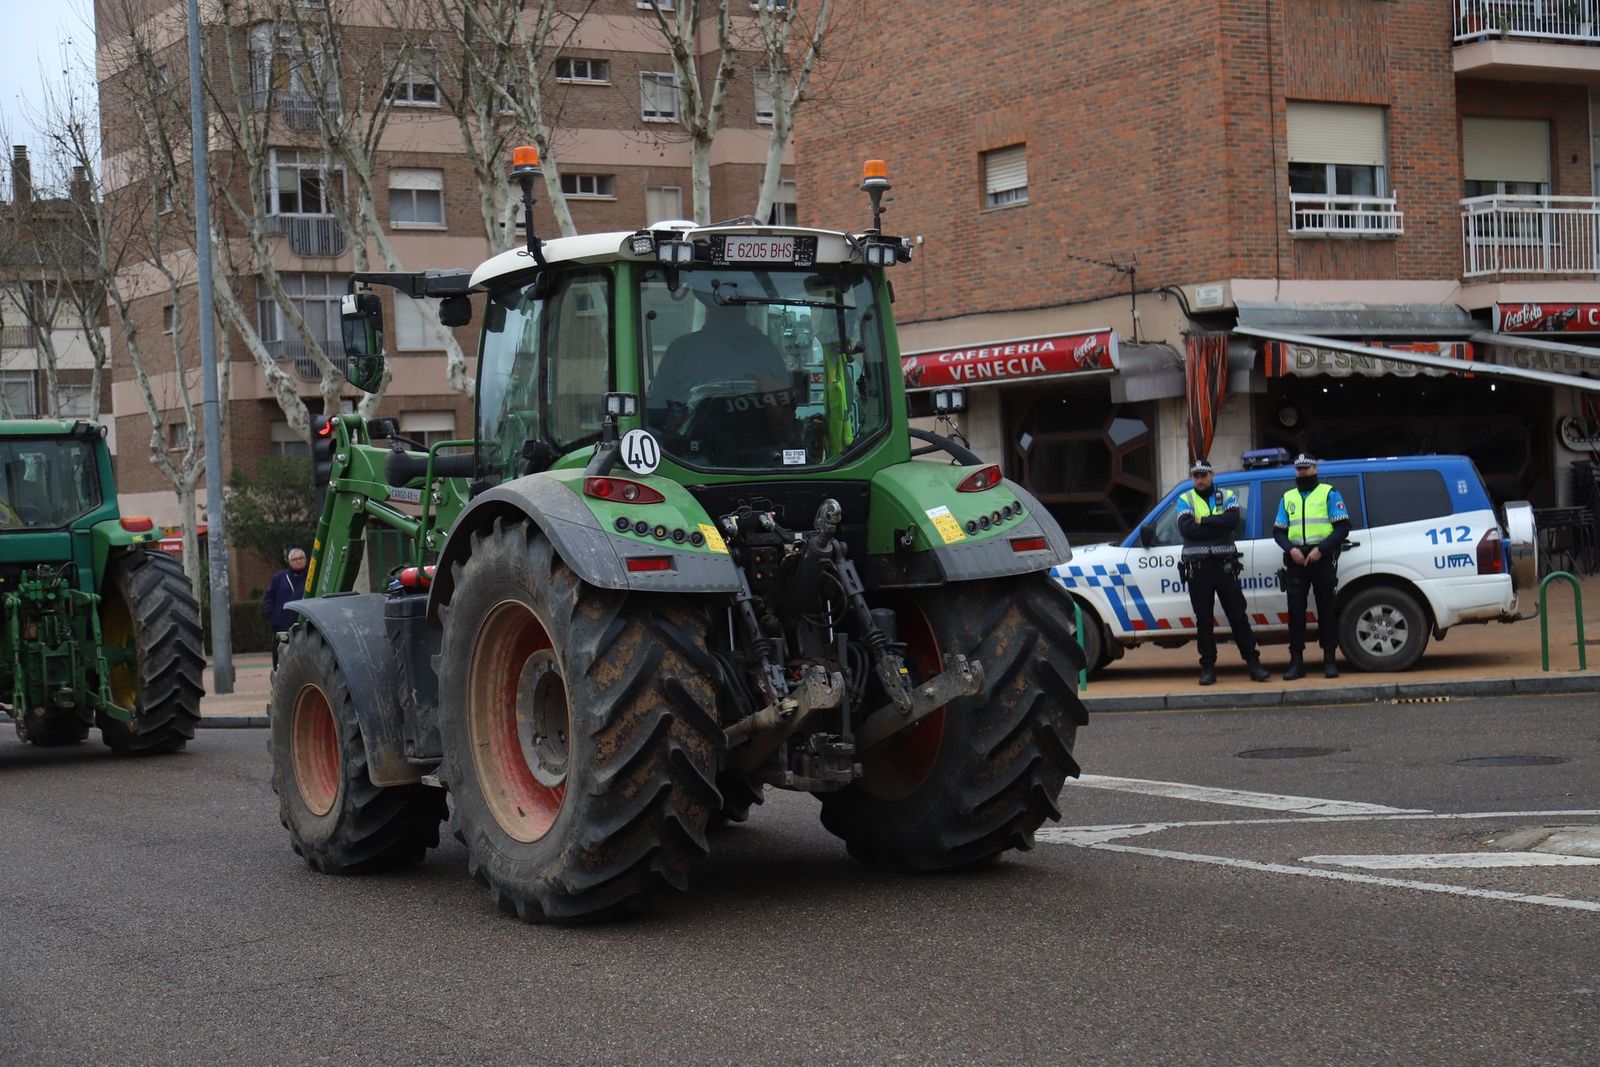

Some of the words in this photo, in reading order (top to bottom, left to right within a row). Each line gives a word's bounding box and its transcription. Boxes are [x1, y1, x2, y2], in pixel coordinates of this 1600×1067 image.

[726, 242, 734, 258] E
[738, 242, 767, 258] 6205
[770, 243, 793, 258] BHS
[938, 341, 1055, 363] CAFETERIA
[949, 356, 1046, 381] VENECIA
[628, 434, 657, 469] 40
[1425, 525, 1473, 545] 112
[1434, 553, 1475, 569] UMA
